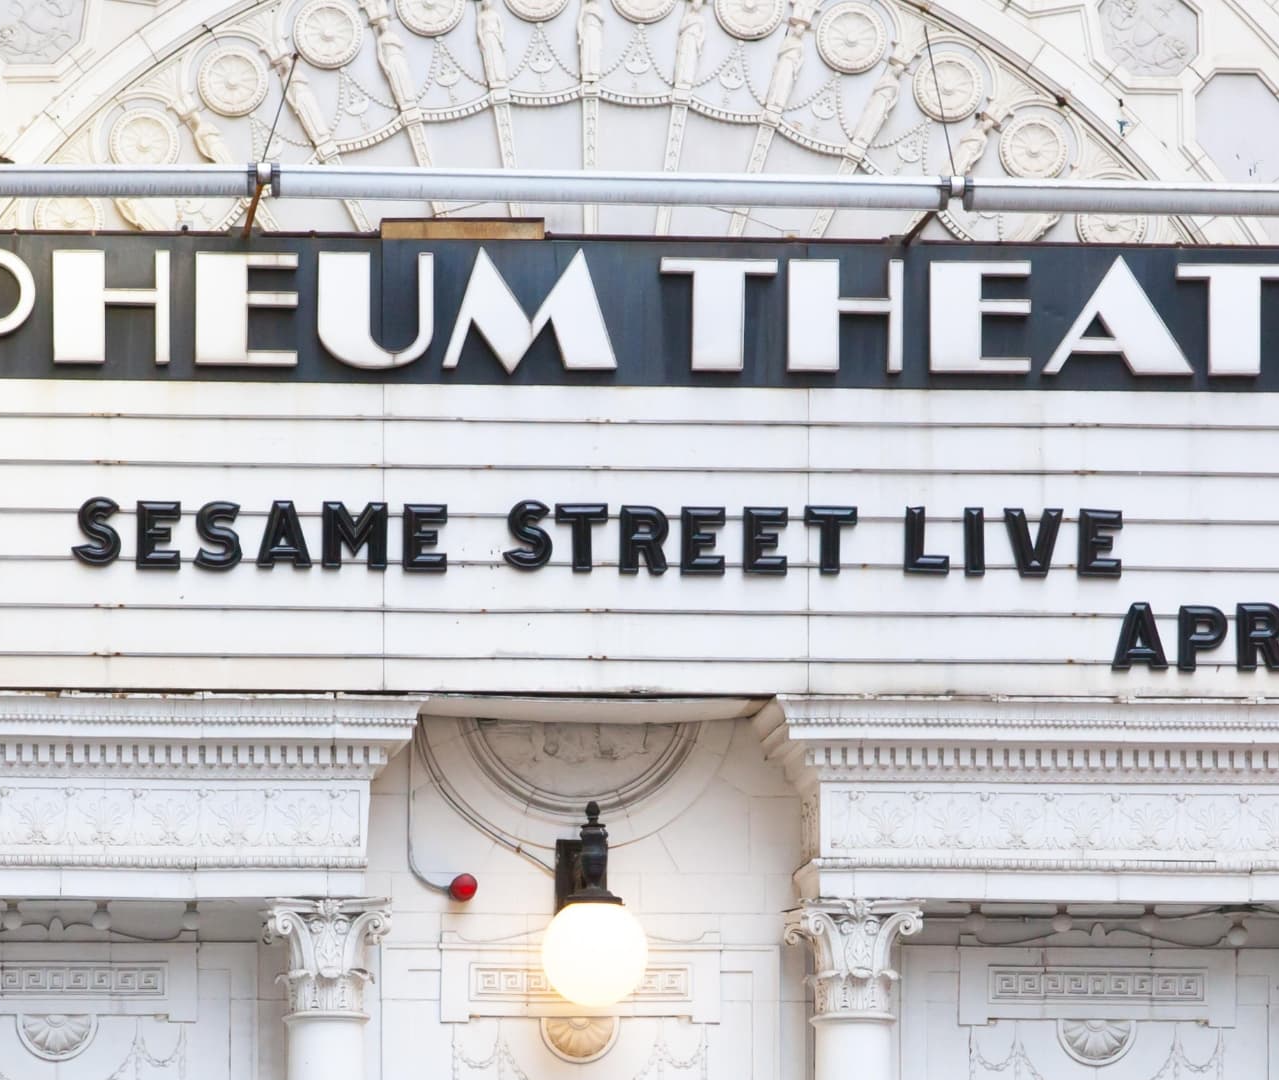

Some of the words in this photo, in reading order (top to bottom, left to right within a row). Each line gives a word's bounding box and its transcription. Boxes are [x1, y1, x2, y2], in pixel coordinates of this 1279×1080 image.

[72, 495, 448, 573] SESAME
[503, 499, 858, 577] STREET
[904, 506, 1123, 578] LIVE
